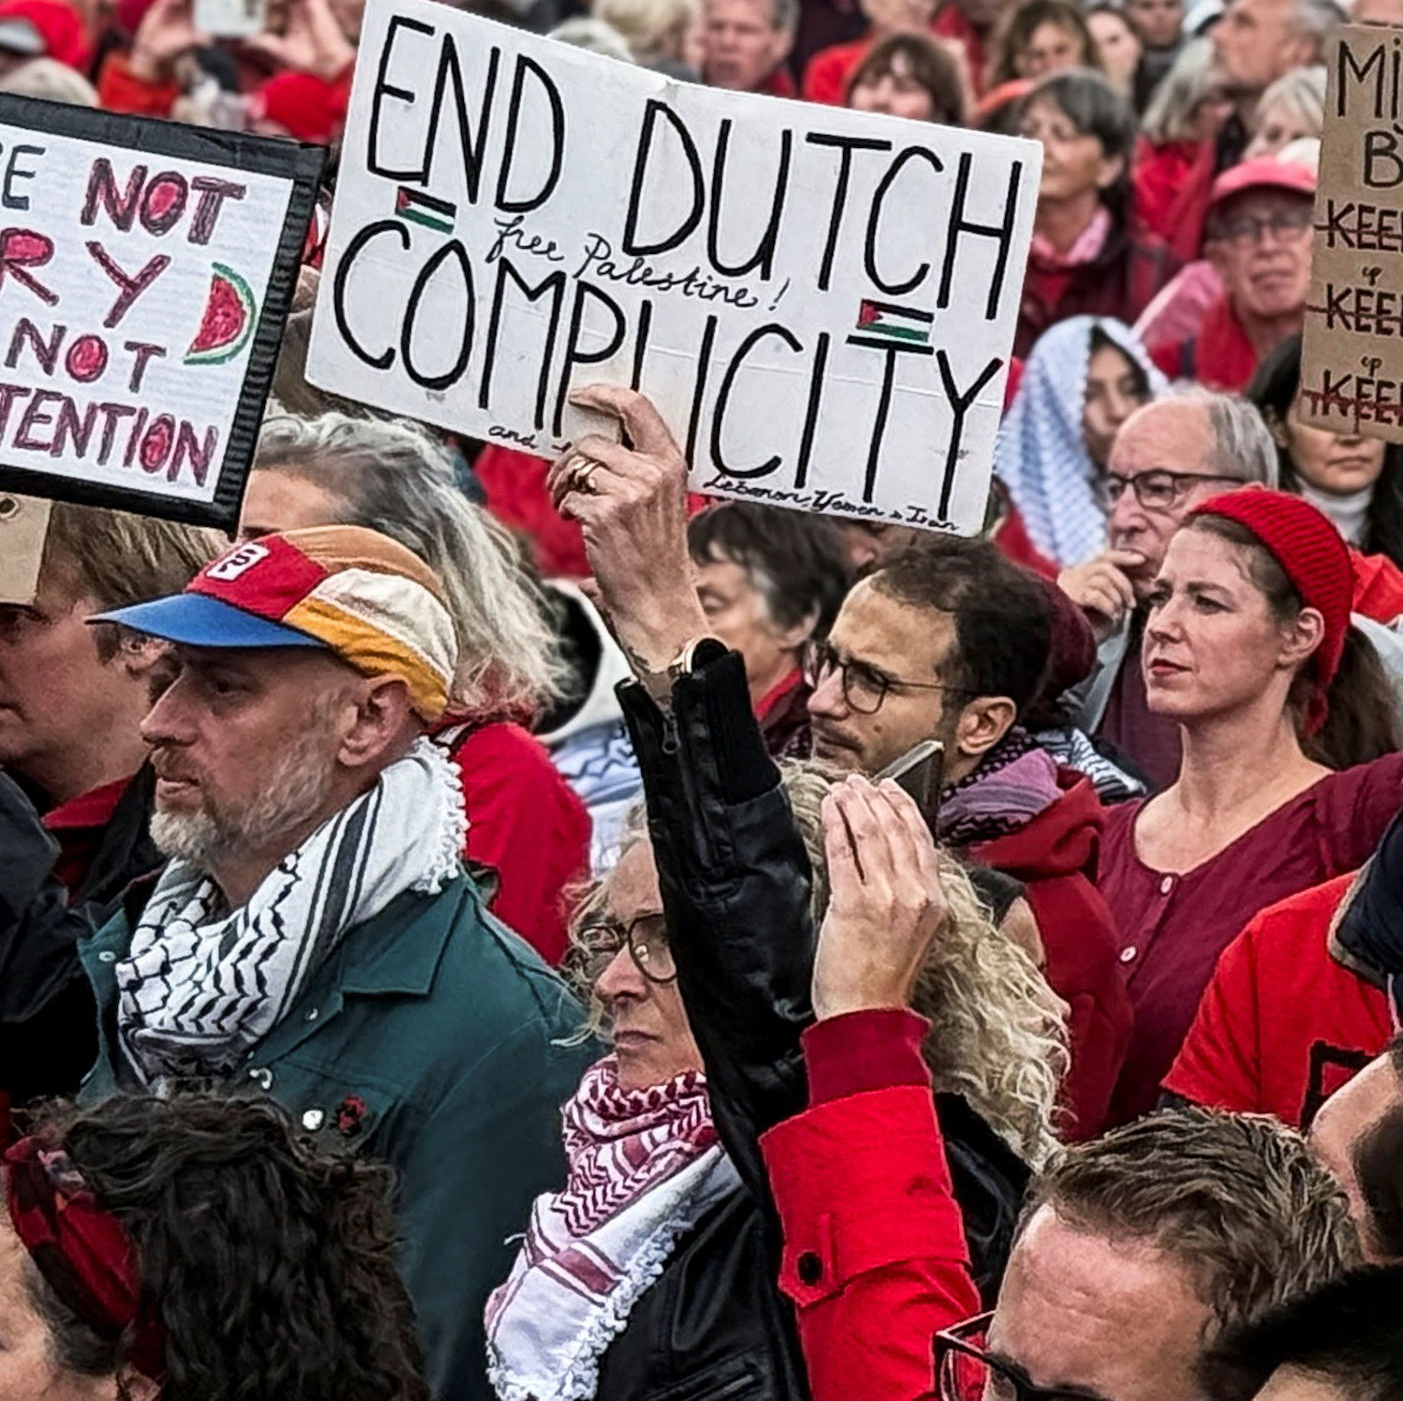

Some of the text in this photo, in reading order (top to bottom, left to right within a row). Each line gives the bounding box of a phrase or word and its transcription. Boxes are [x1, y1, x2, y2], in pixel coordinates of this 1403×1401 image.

[0, 142, 247, 246] E NOT
[366, 14, 1024, 321] END DUTCH
[3, 317, 168, 393] NOT
